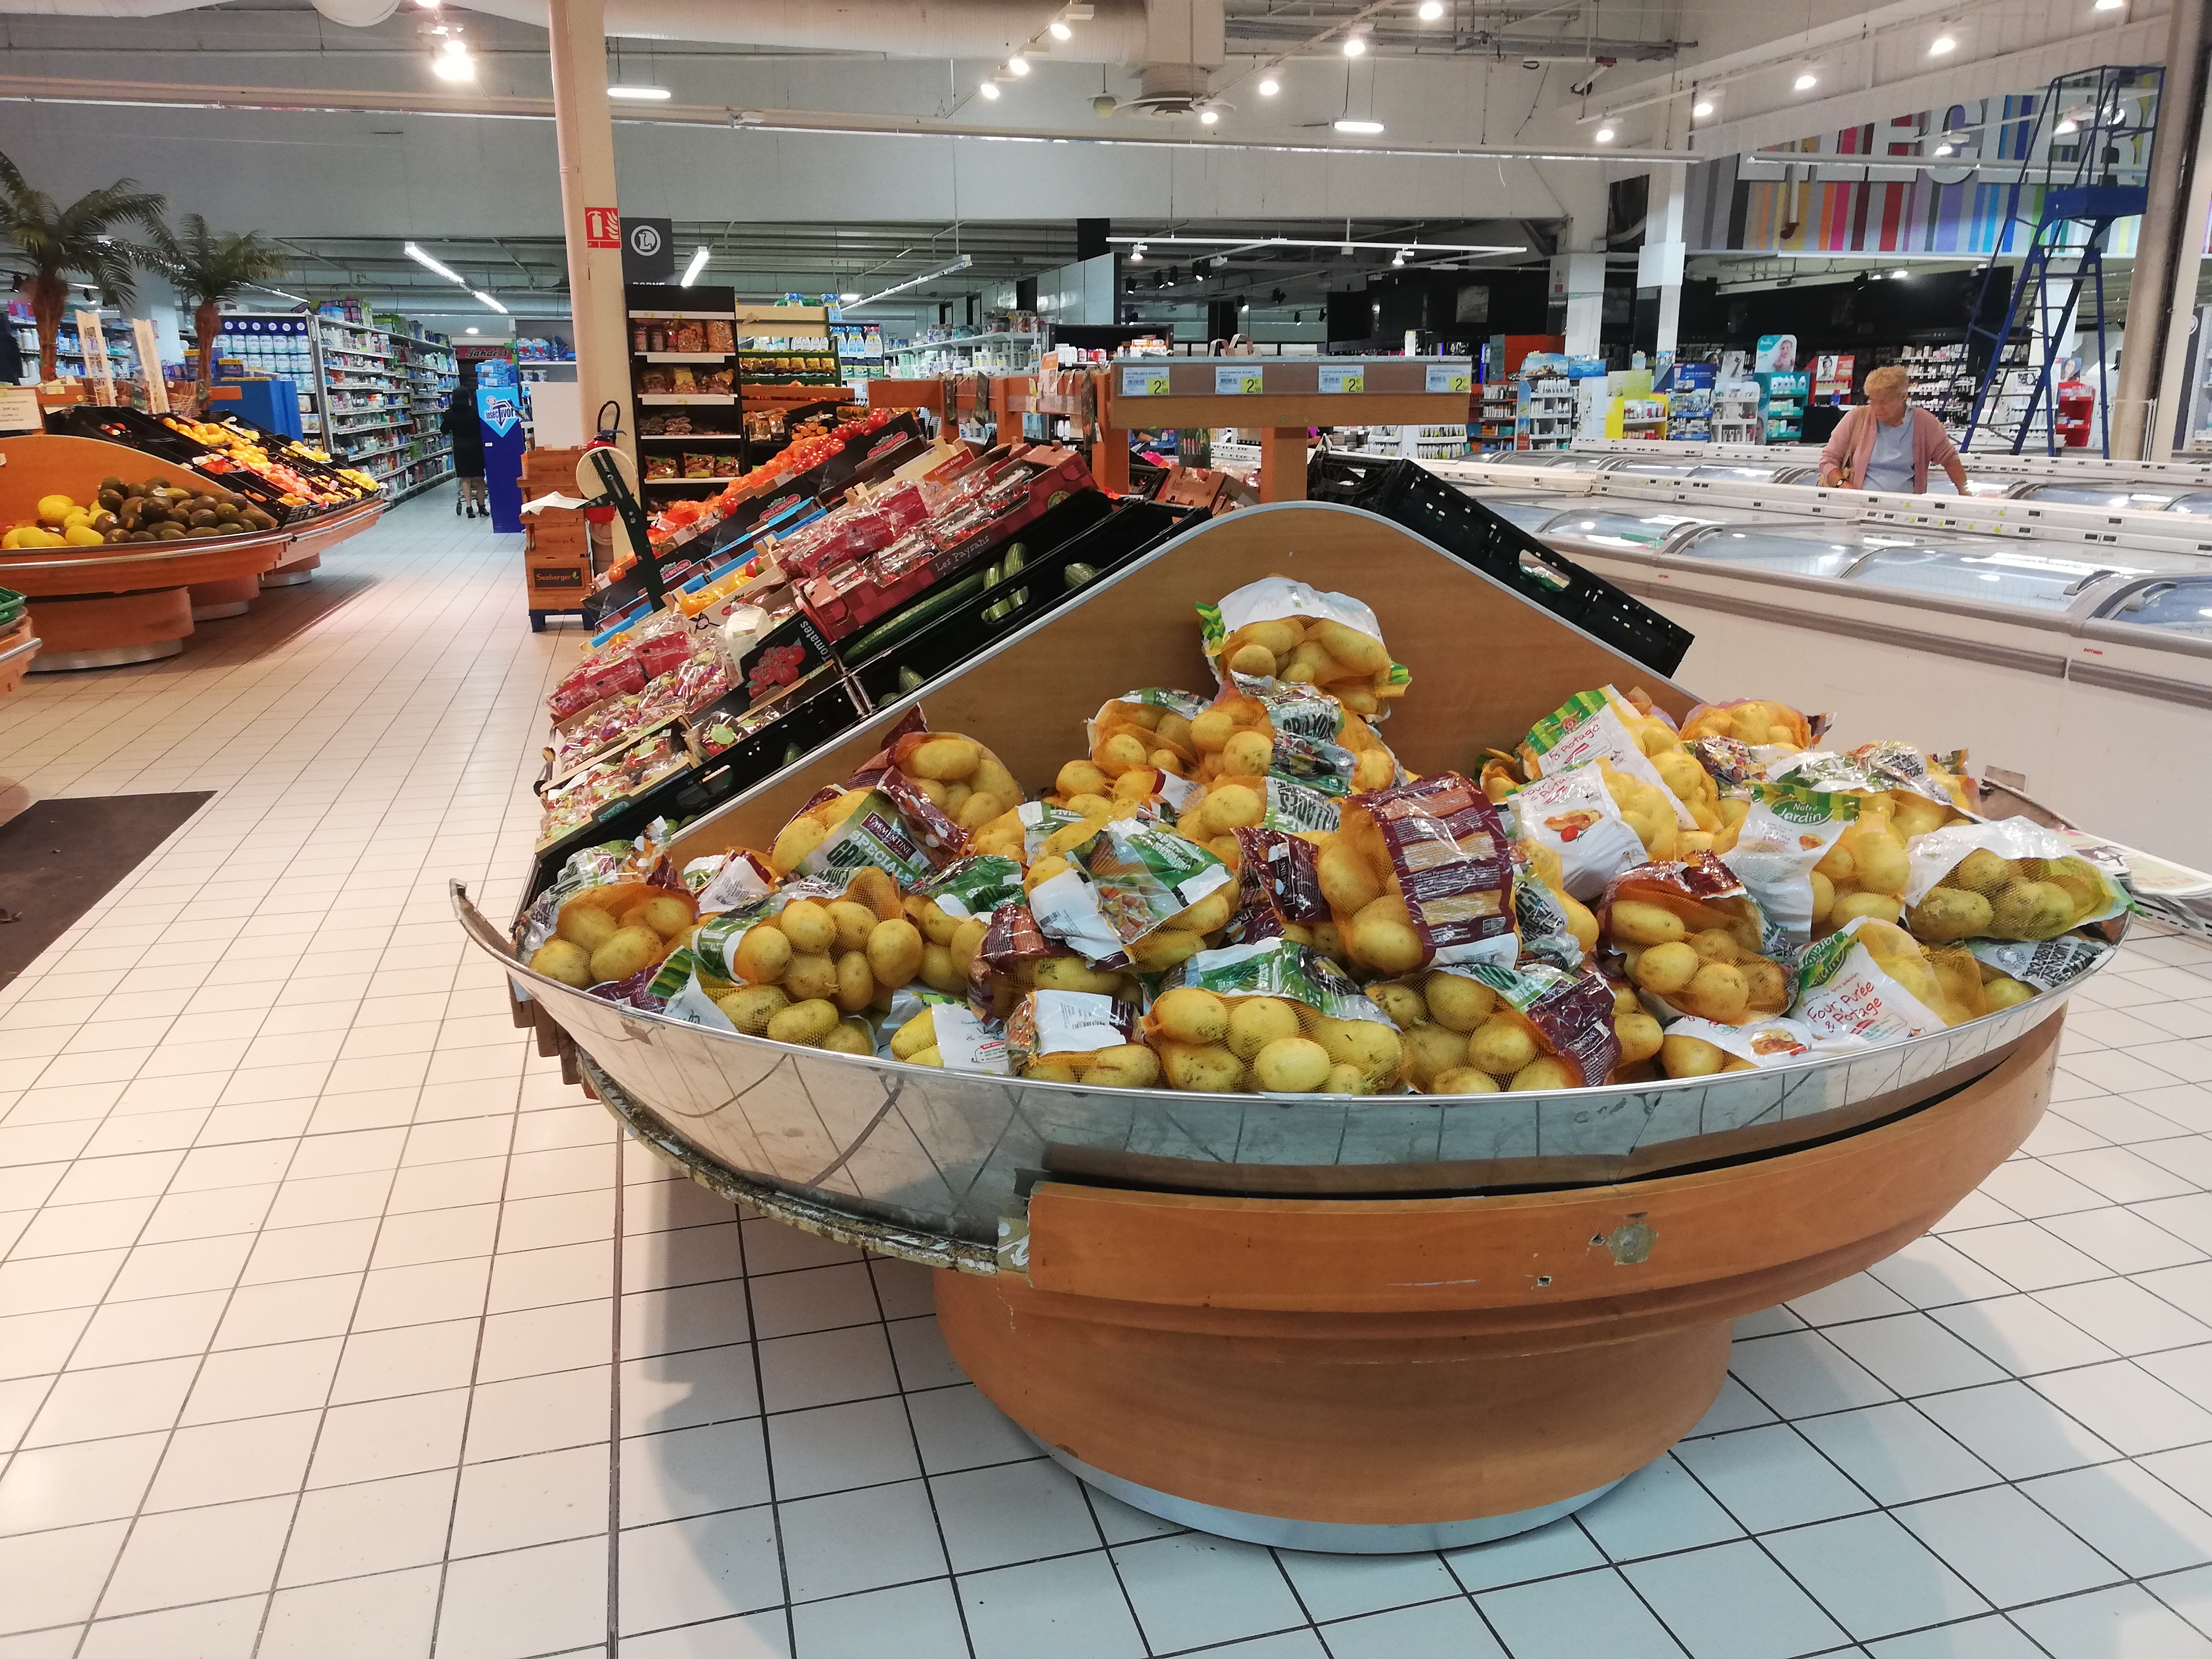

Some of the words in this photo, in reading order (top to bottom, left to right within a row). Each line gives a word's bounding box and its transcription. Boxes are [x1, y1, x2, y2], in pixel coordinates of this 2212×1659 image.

[536, 574, 572, 583] Seeberger
[800, 621, 831, 662] Tomates
[1778, 807, 1822, 823] Jardin
[868, 815, 913, 855] PARMENTINE
[1806, 1001, 1837, 1023] Four
[1840, 982, 1874, 1005] Purée
[1832, 997, 1882, 1025] Potage
